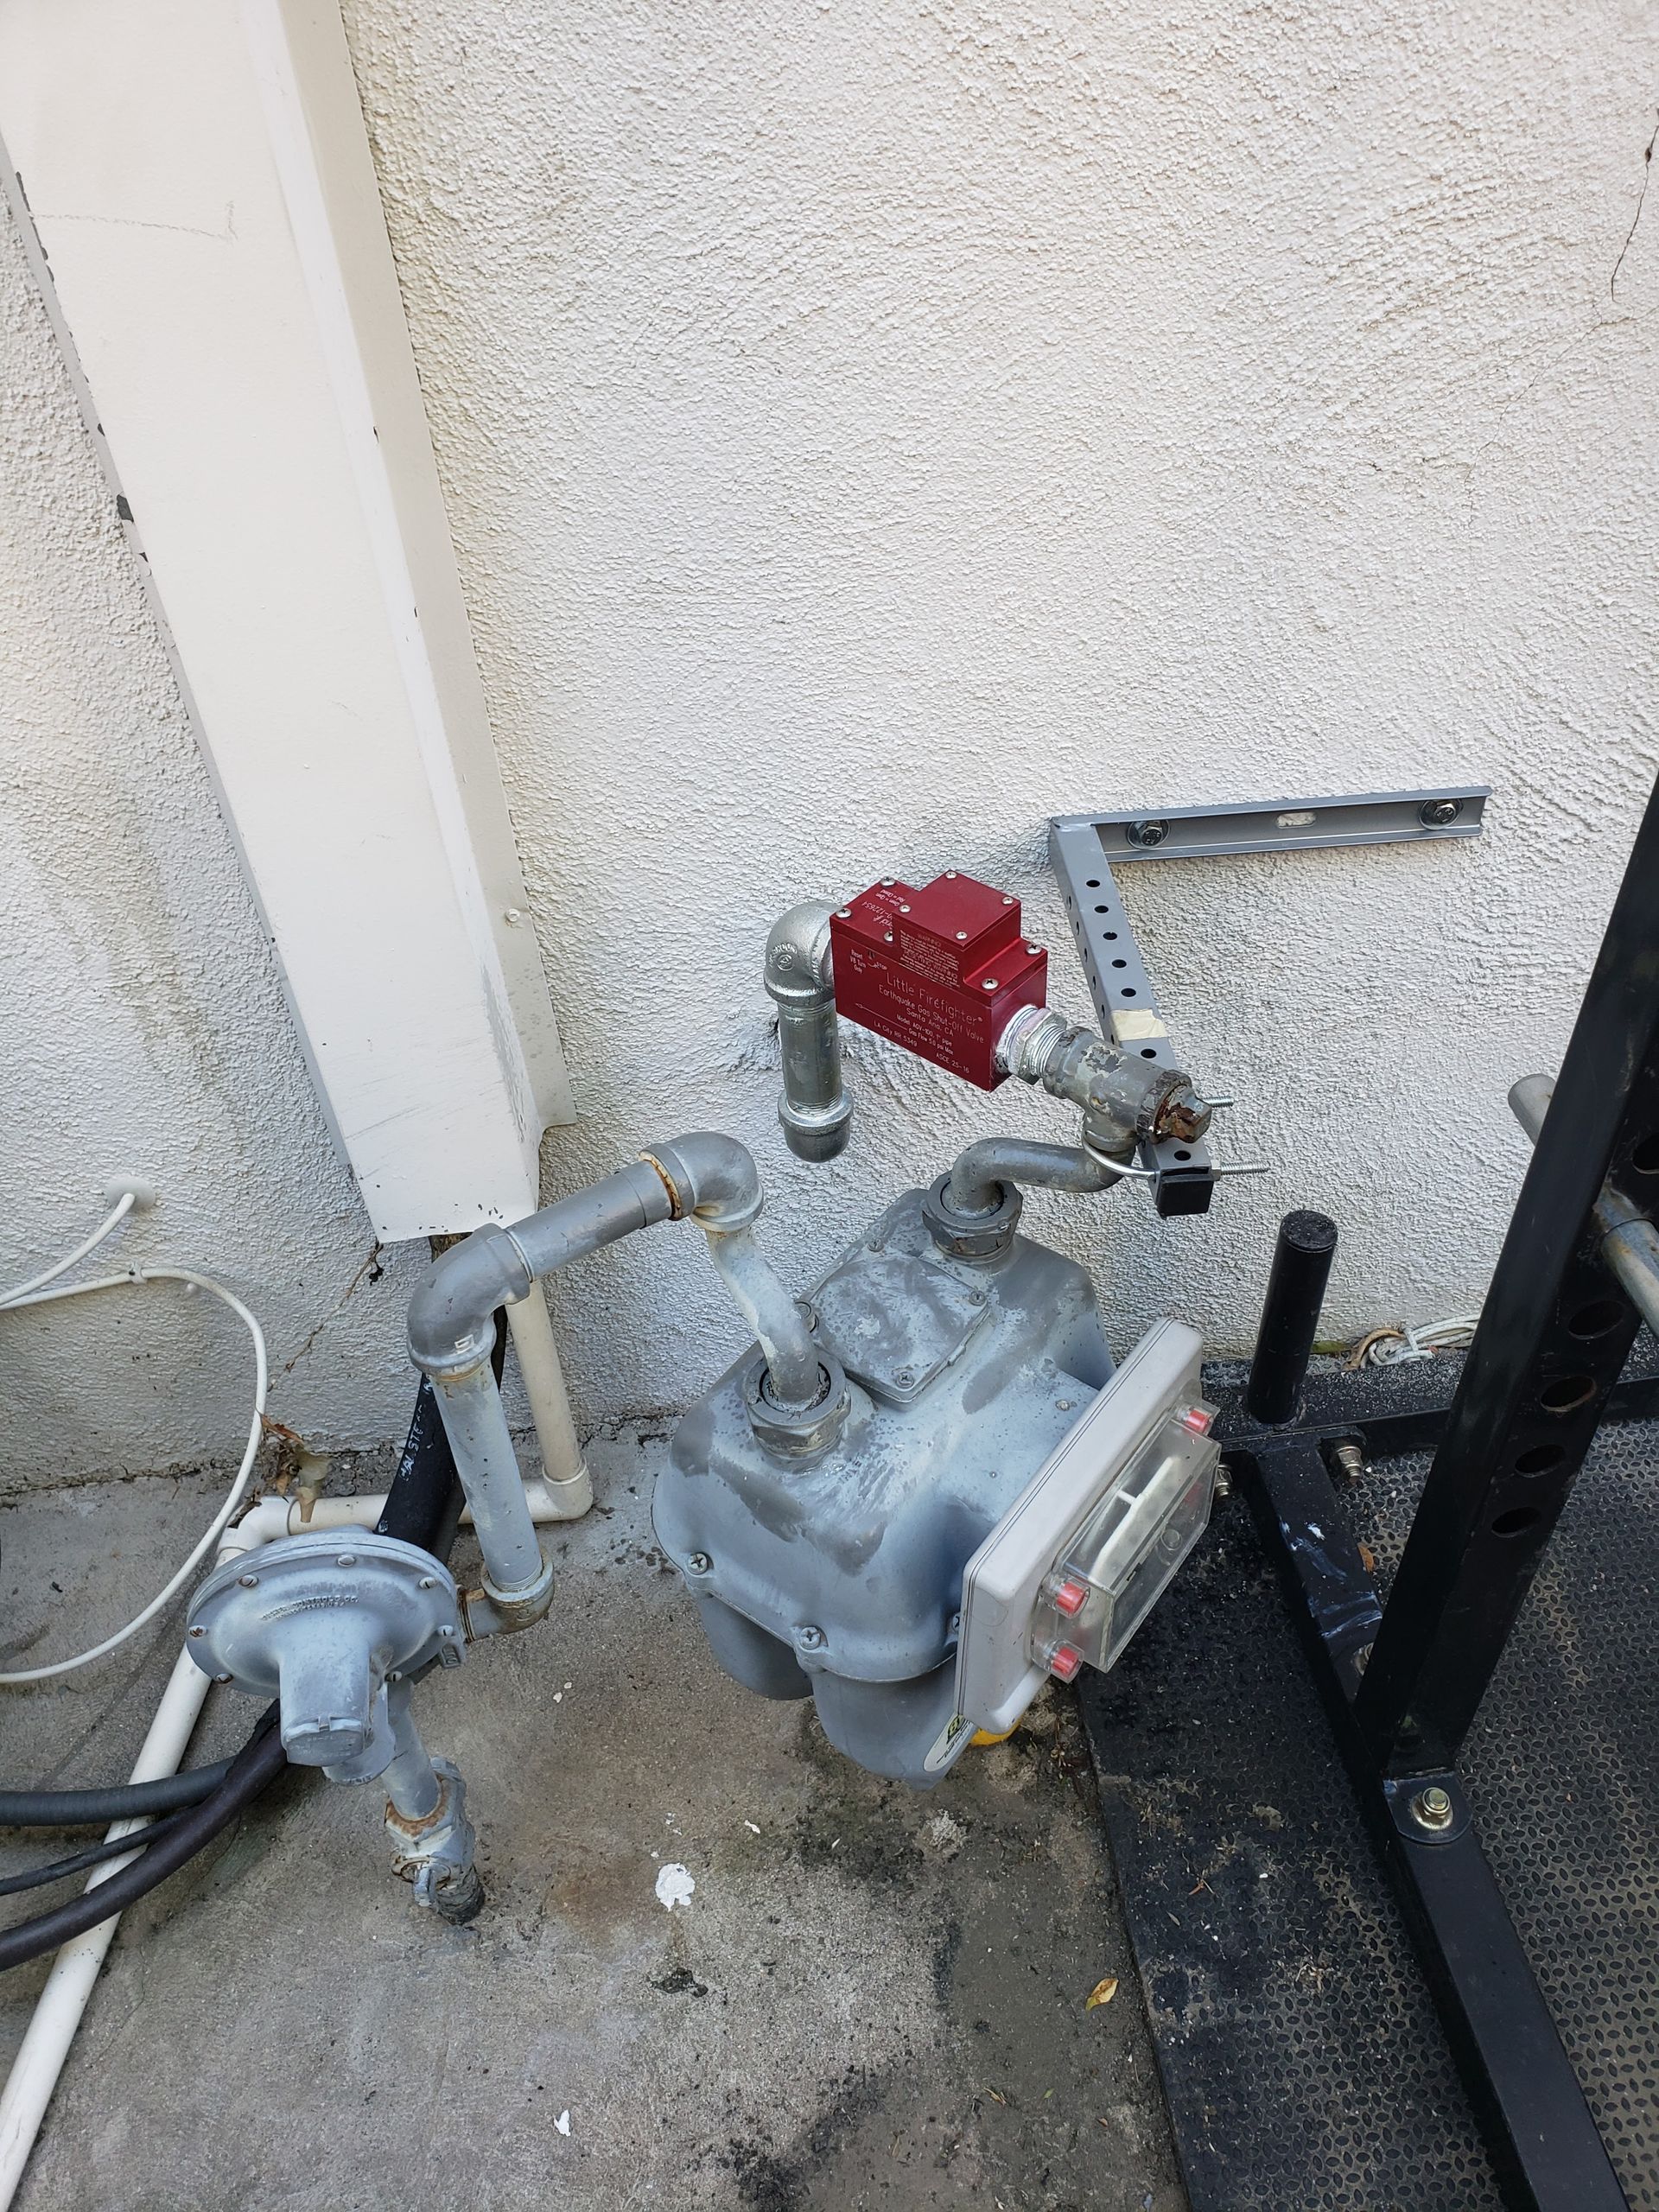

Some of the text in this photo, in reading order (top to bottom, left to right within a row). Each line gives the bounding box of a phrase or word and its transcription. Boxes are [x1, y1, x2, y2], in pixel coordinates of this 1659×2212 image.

[851, 949, 862, 960] Reset
[887, 972, 914, 996] Little
[879, 983, 984, 1044] Earthquake Gas Shut-Off Valve
[906, 1007, 925, 1022] Santa
[944, 1026, 954, 1037] CA
[874, 1020, 880, 1029] LA
[908, 1027, 917, 1037] Gas
[918, 1032, 928, 1042] Flow
[944, 1046, 954, 1056] Max
[942, 1038, 953, 1047] pipe
[936, 1052, 950, 1064] ASCE
